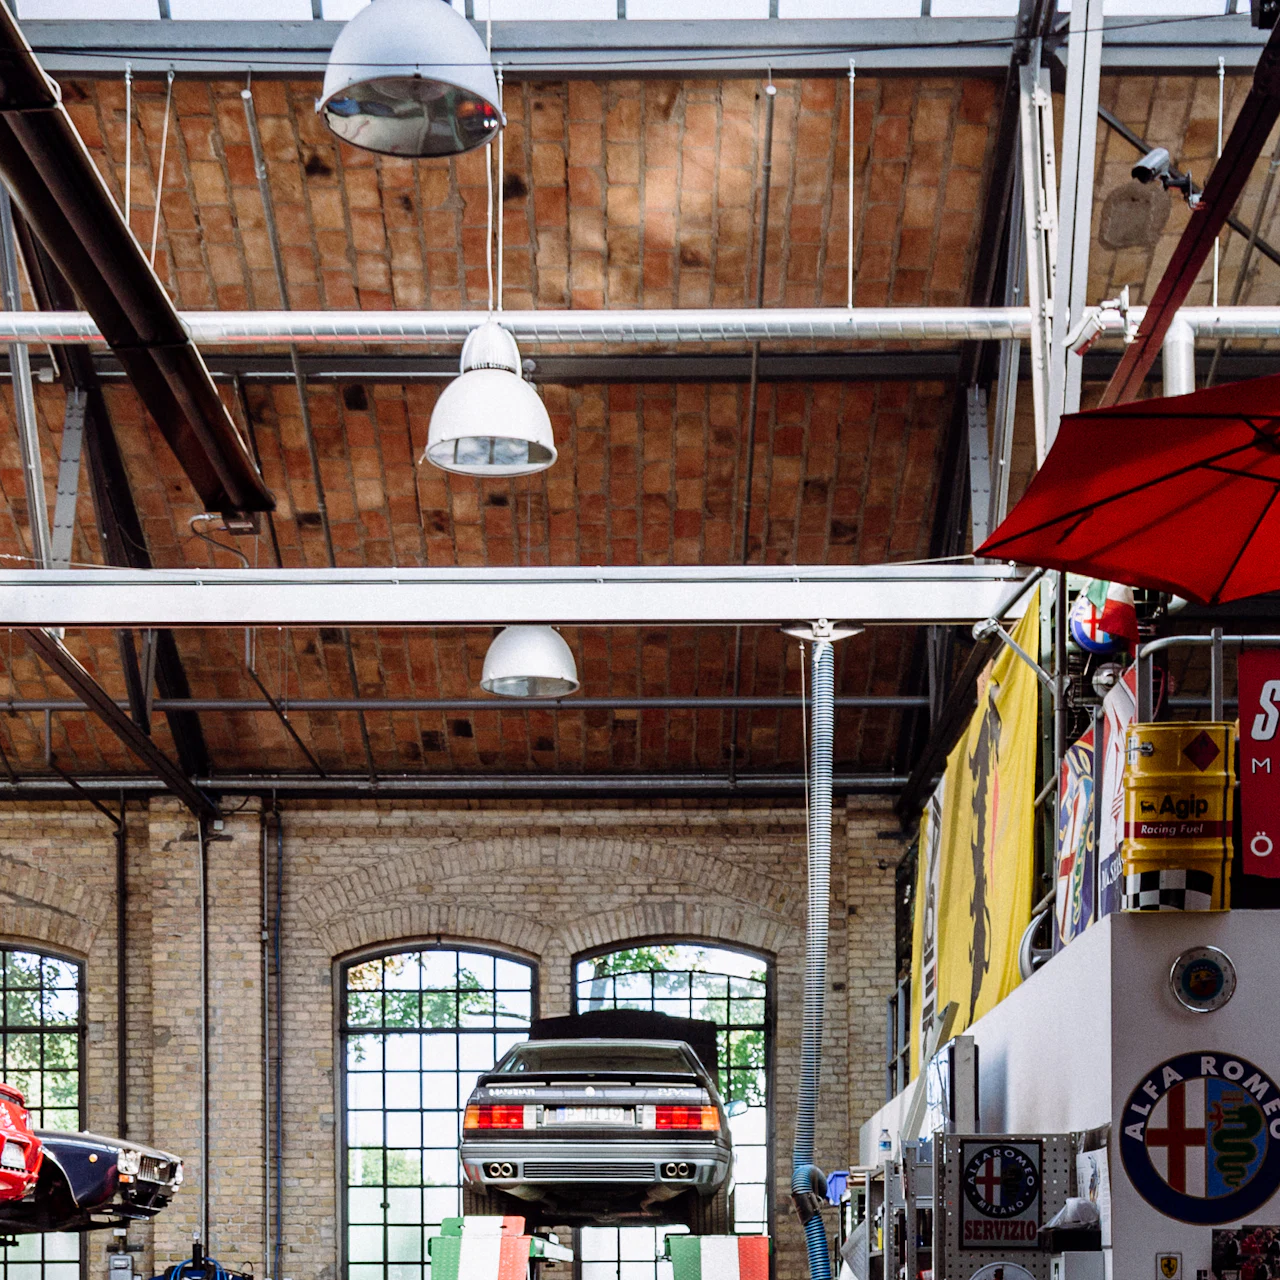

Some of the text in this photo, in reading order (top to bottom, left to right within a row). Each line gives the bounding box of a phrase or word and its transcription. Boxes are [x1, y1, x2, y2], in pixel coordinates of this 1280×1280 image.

[1159, 793, 1209, 819] Agip
[1141, 823, 1204, 837] Racing Fuel
[1124, 1065, 1184, 1142] ALFA
[977, 1200, 1024, 1214] MILANO
[964, 1220, 1037, 1241] SERVIZIO
